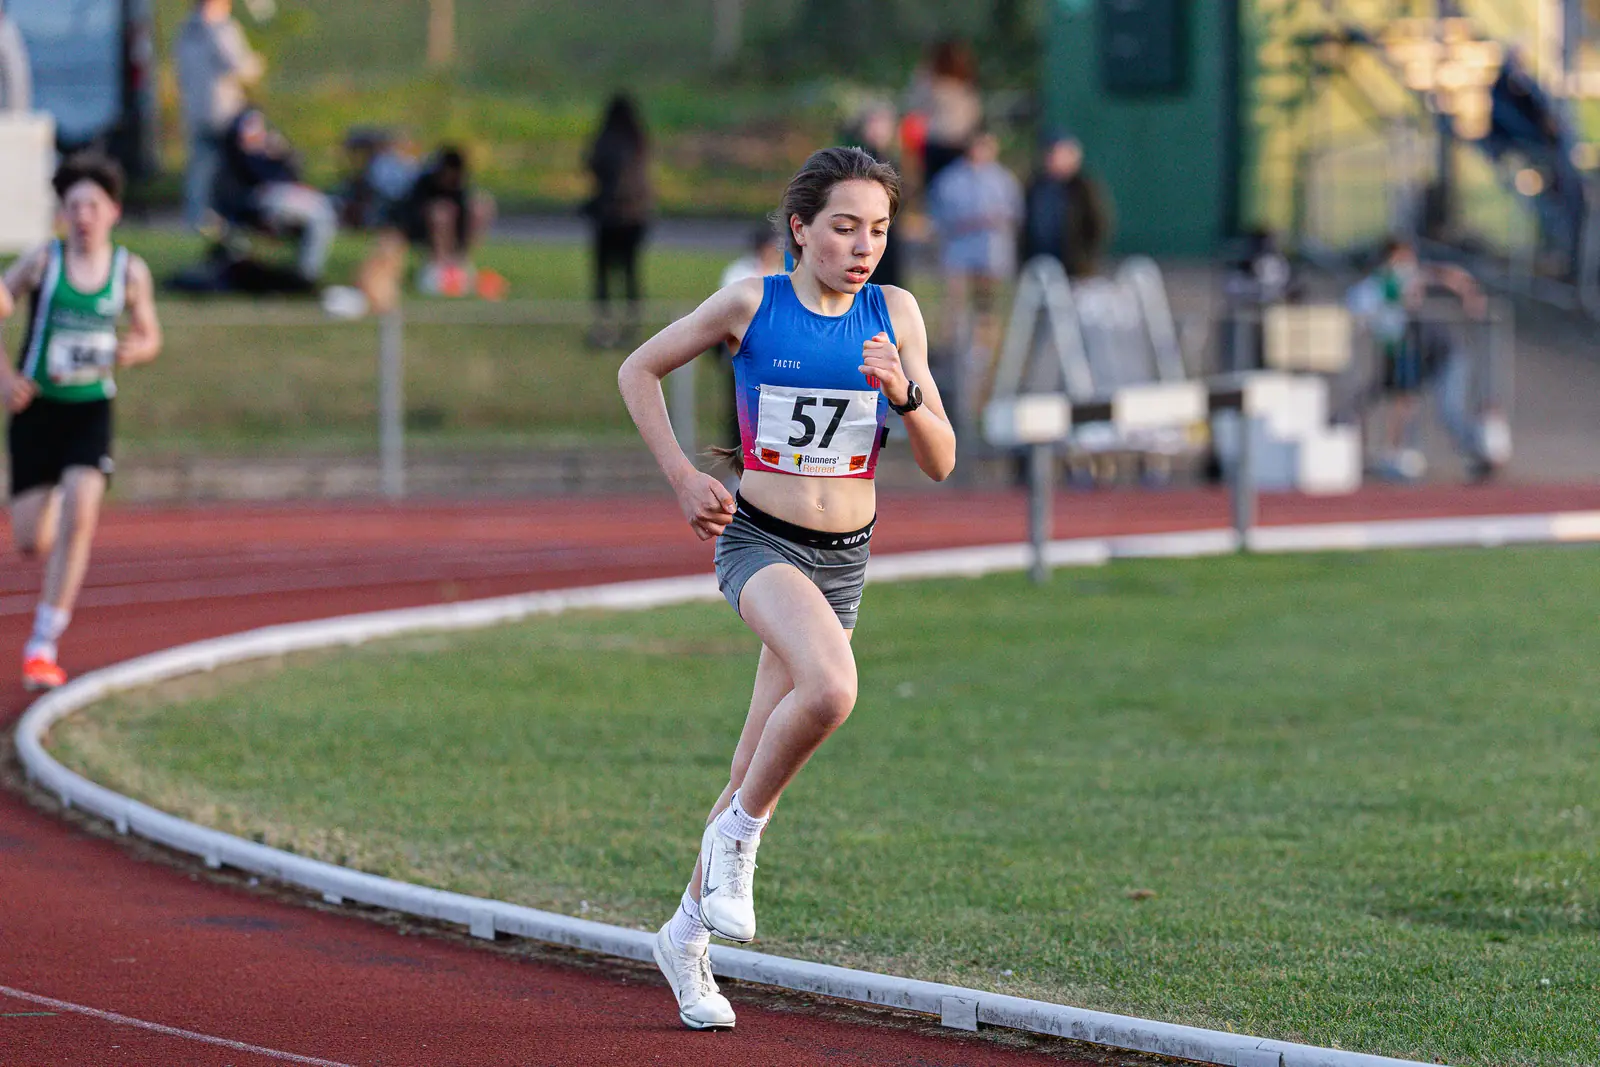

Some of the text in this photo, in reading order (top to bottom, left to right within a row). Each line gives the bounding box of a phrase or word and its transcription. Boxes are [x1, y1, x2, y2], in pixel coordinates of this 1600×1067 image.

[772, 358, 801, 370] TACTIC
[787, 396, 850, 449] 57
[803, 454, 840, 465] Runners'
[802, 464, 836, 473] Retreat
